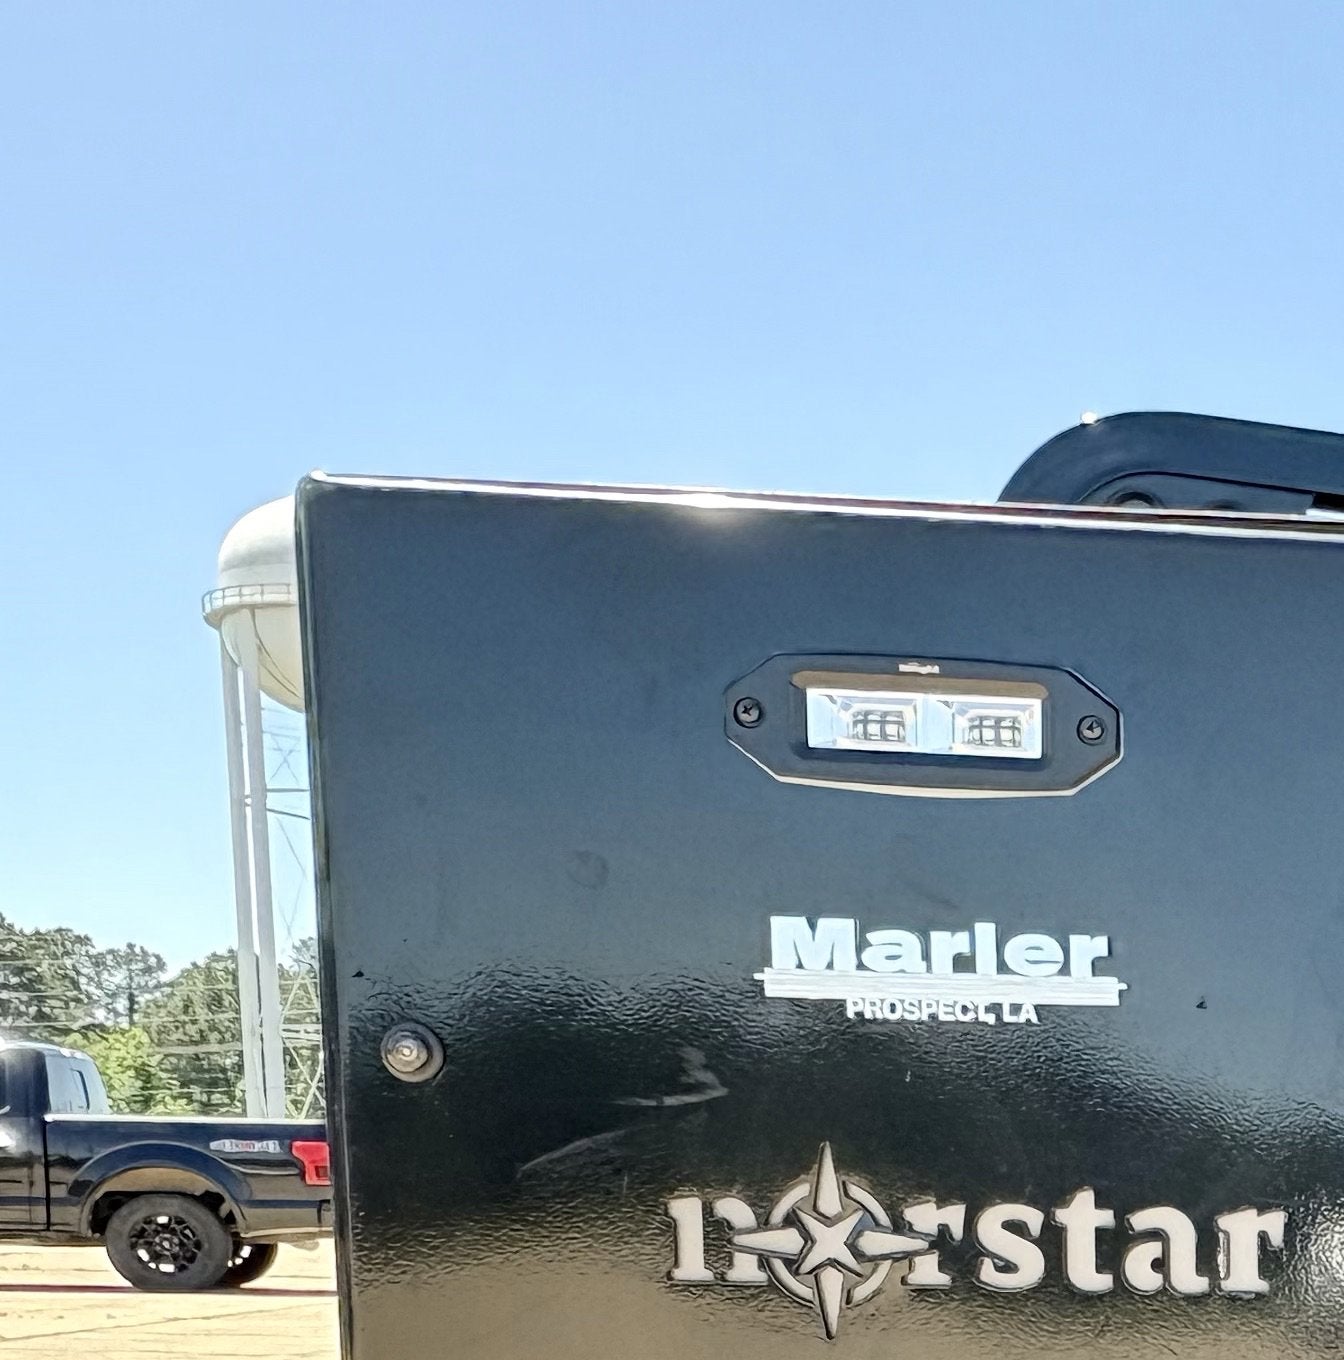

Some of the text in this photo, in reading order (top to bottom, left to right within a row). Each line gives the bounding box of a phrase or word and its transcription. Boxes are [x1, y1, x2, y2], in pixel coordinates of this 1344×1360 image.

[769, 915, 1109, 979] Marler
[846, 998, 1042, 1025] PROSPECT, LA
